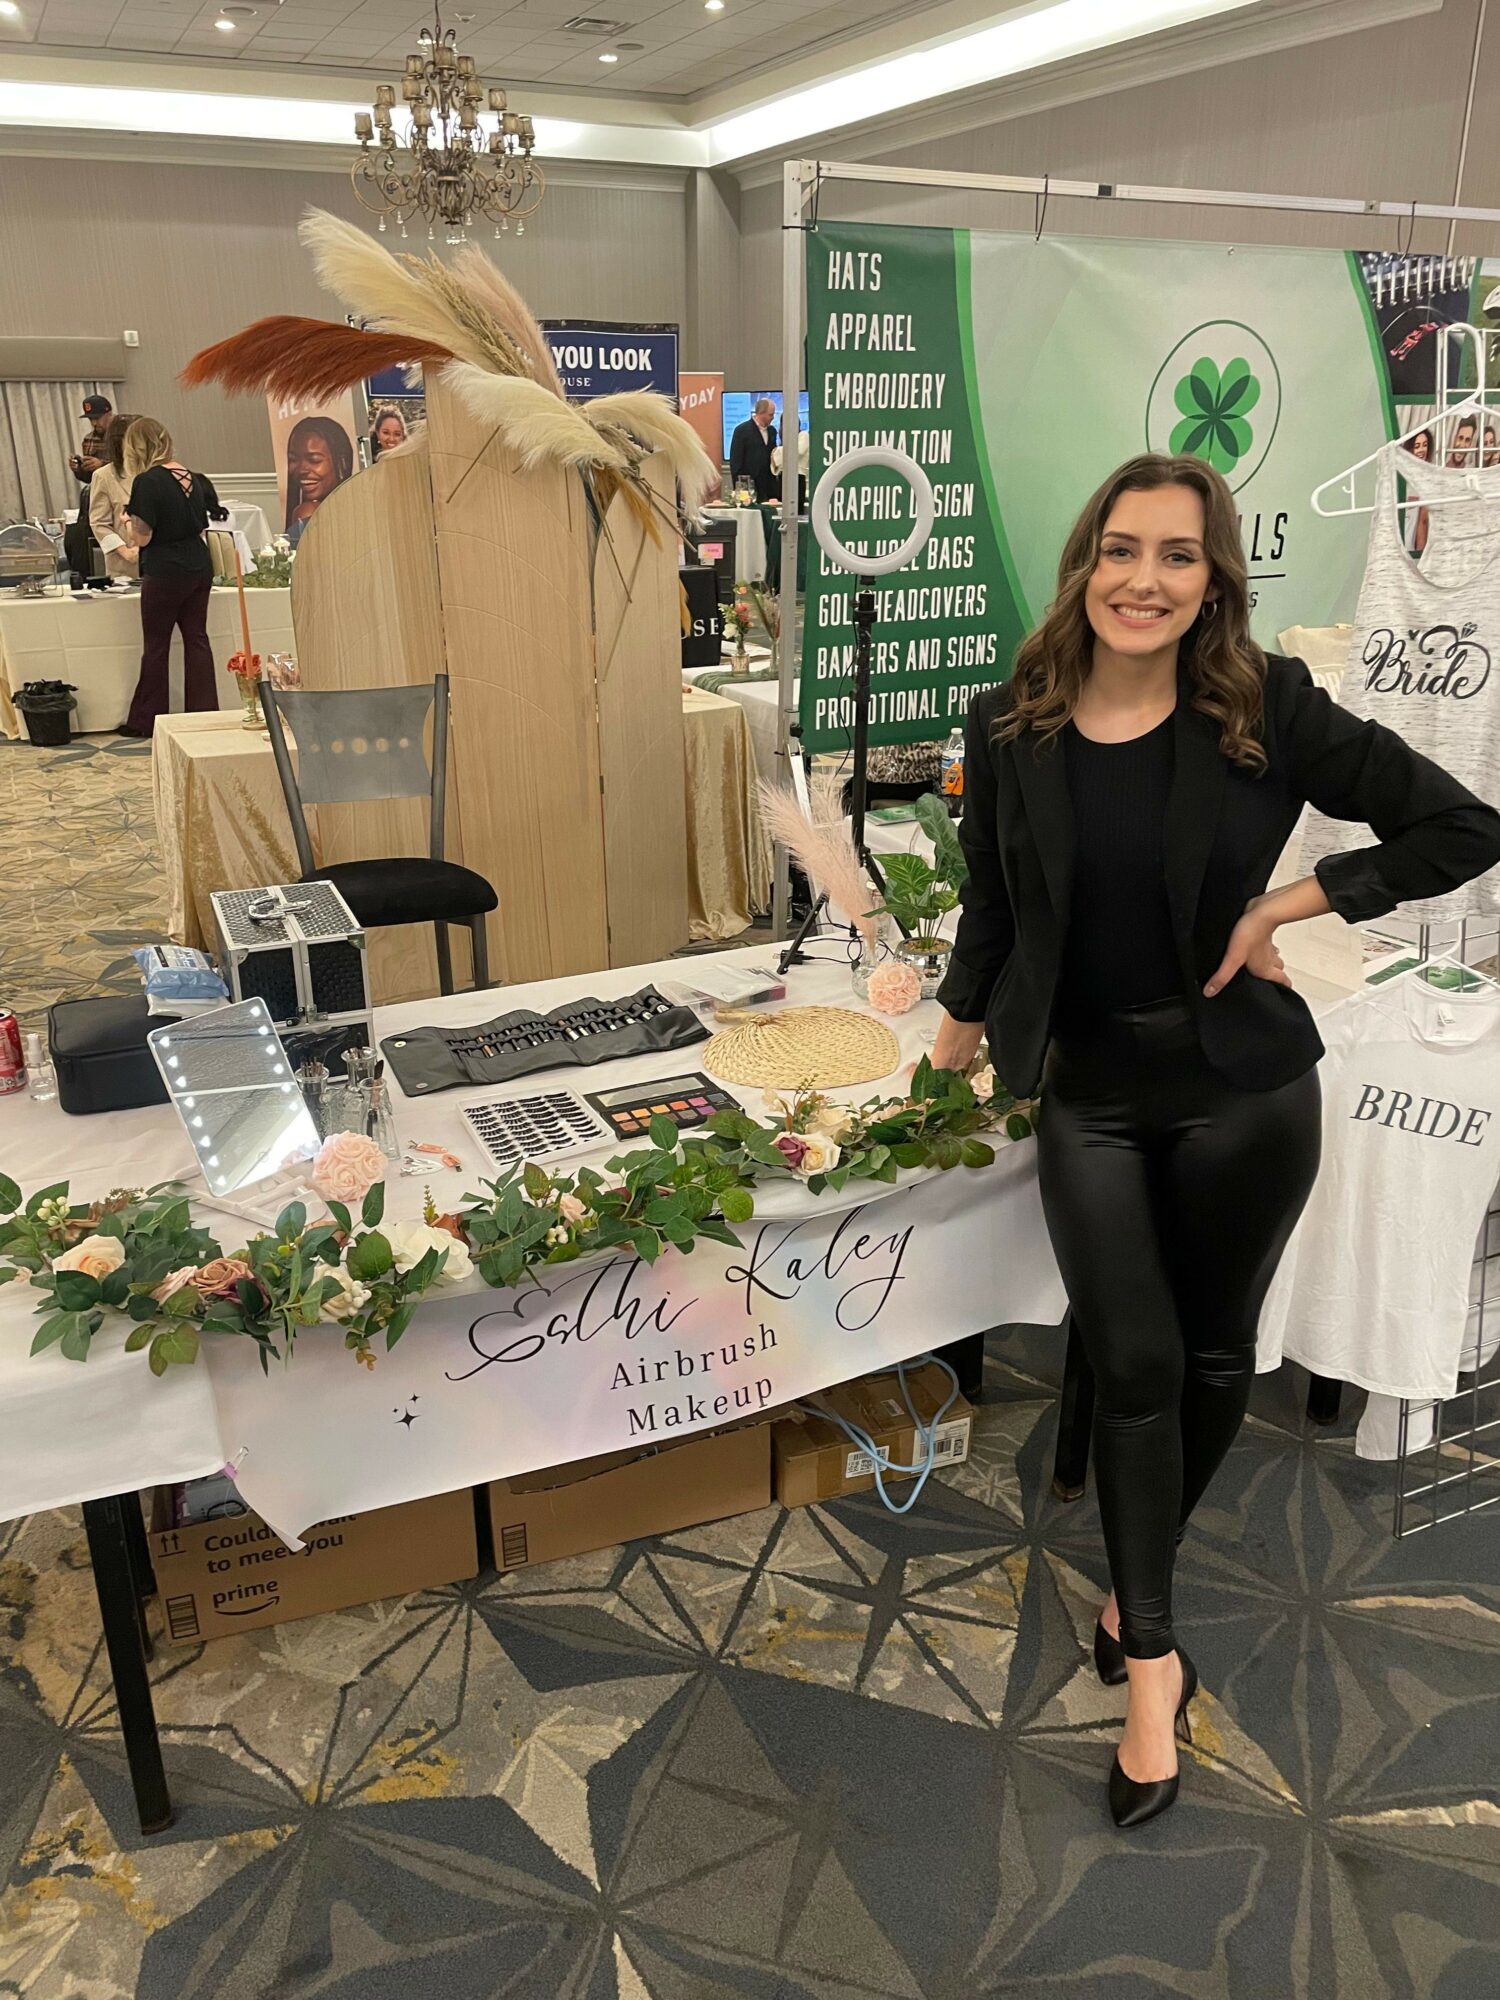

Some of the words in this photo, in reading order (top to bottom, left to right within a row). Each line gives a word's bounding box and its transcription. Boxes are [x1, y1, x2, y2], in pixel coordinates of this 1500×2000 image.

[827, 251, 882, 291] HATS
[825, 313, 916, 351] APPAREL
[551, 345, 594, 369] YOU
[598, 347, 652, 371] LOOK
[823, 372, 946, 409] EMBROIDERY
[829, 485, 903, 522] RAPHIC
[909, 483, 975, 519] DSIGN
[927, 536, 975, 570] BAGS
[873, 584, 987, 624] HEADCOVERS
[817, 641, 900, 680] BANERS
[905, 638, 941, 672] AND
[947, 633, 997, 668] SIGNS
[1363, 624, 1491, 700] Bride
[1349, 1083, 1492, 1147] BRIDE
[610, 1323, 779, 1390] Airbrush
[627, 1373, 775, 1437] Makeup
[204, 1524, 278, 1552] Could
[207, 1559, 231, 1574] to
[303, 1533, 344, 1557] you
[213, 1579, 279, 1608] prime
